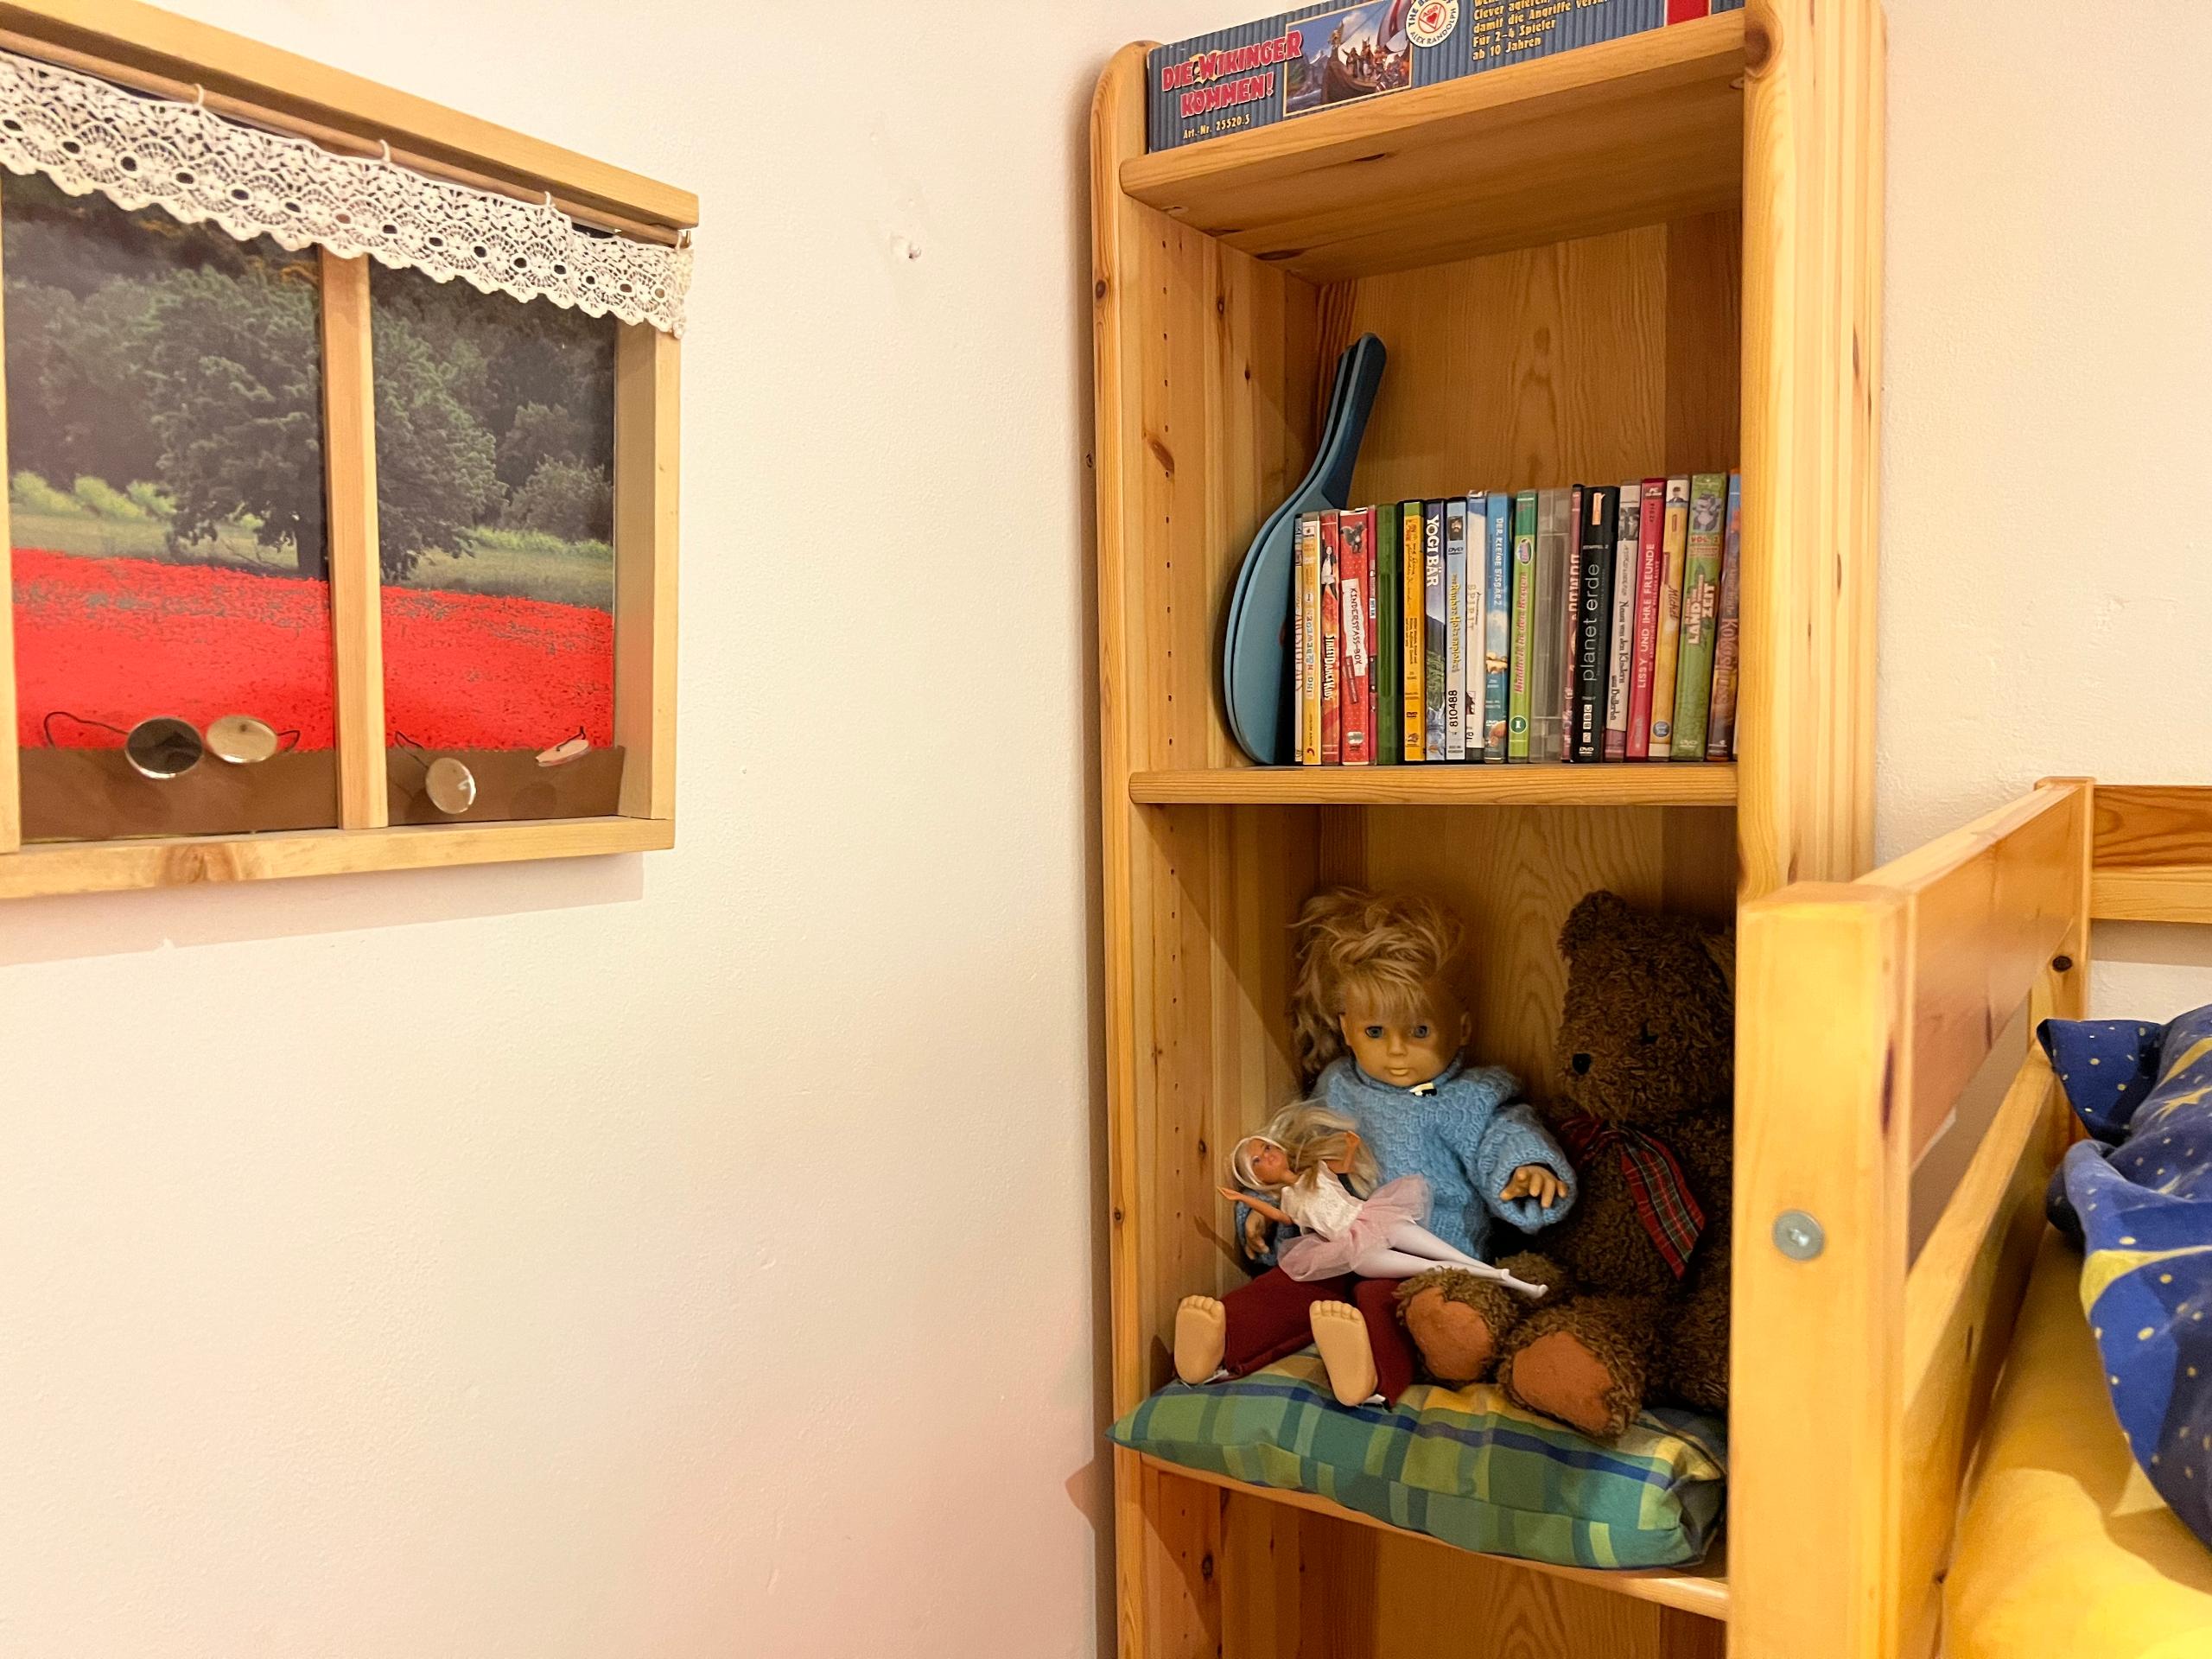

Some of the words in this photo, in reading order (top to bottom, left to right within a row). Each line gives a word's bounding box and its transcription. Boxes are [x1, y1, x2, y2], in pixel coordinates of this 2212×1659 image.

[1408, 8, 1419, 28] THE
[1410, 31, 1426, 44] ALEX
[1427, 8, 1457, 44] RANDOLPH
[1472, 35, 1491, 48] Für
[1519, 19, 1556, 36] Spieler
[1473, 17, 1503, 34] damit
[1508, 13, 1524, 25] die
[1529, 2, 1571, 21] Angriffe
[1161, 60, 1195, 92] DIE
[1198, 29, 1303, 81] WIKINGER
[1472, 49, 1485, 60] ab
[1490, 44, 1501, 56] 10
[1505, 36, 1541, 53] Jahren
[1180, 71, 1274, 118] KOMMEN!
[1426, 513, 1440, 553] YOGI
[1495, 517, 1504, 537] DER
[1447, 546, 1464, 556] DVD
[1494, 537, 1504, 567] KLEINE
[1426, 554, 1442, 588] BÄR
[1644, 543, 1655, 594] FREUNDE
[1584, 563, 1600, 611] erde
[1701, 582, 1715, 618] ZEIT
[1350, 588, 1363, 665] KINDERSPASS-BOX
[1642, 598, 1651, 624] IHRE
[1688, 601, 1701, 645] LAND
[1580, 618, 1598, 682] planet
[1640, 628, 1649, 652] UND
[1637, 658, 1648, 689] LISSY
[1447, 690, 1459, 728] 810488
[1583, 704, 1592, 730] BBC
